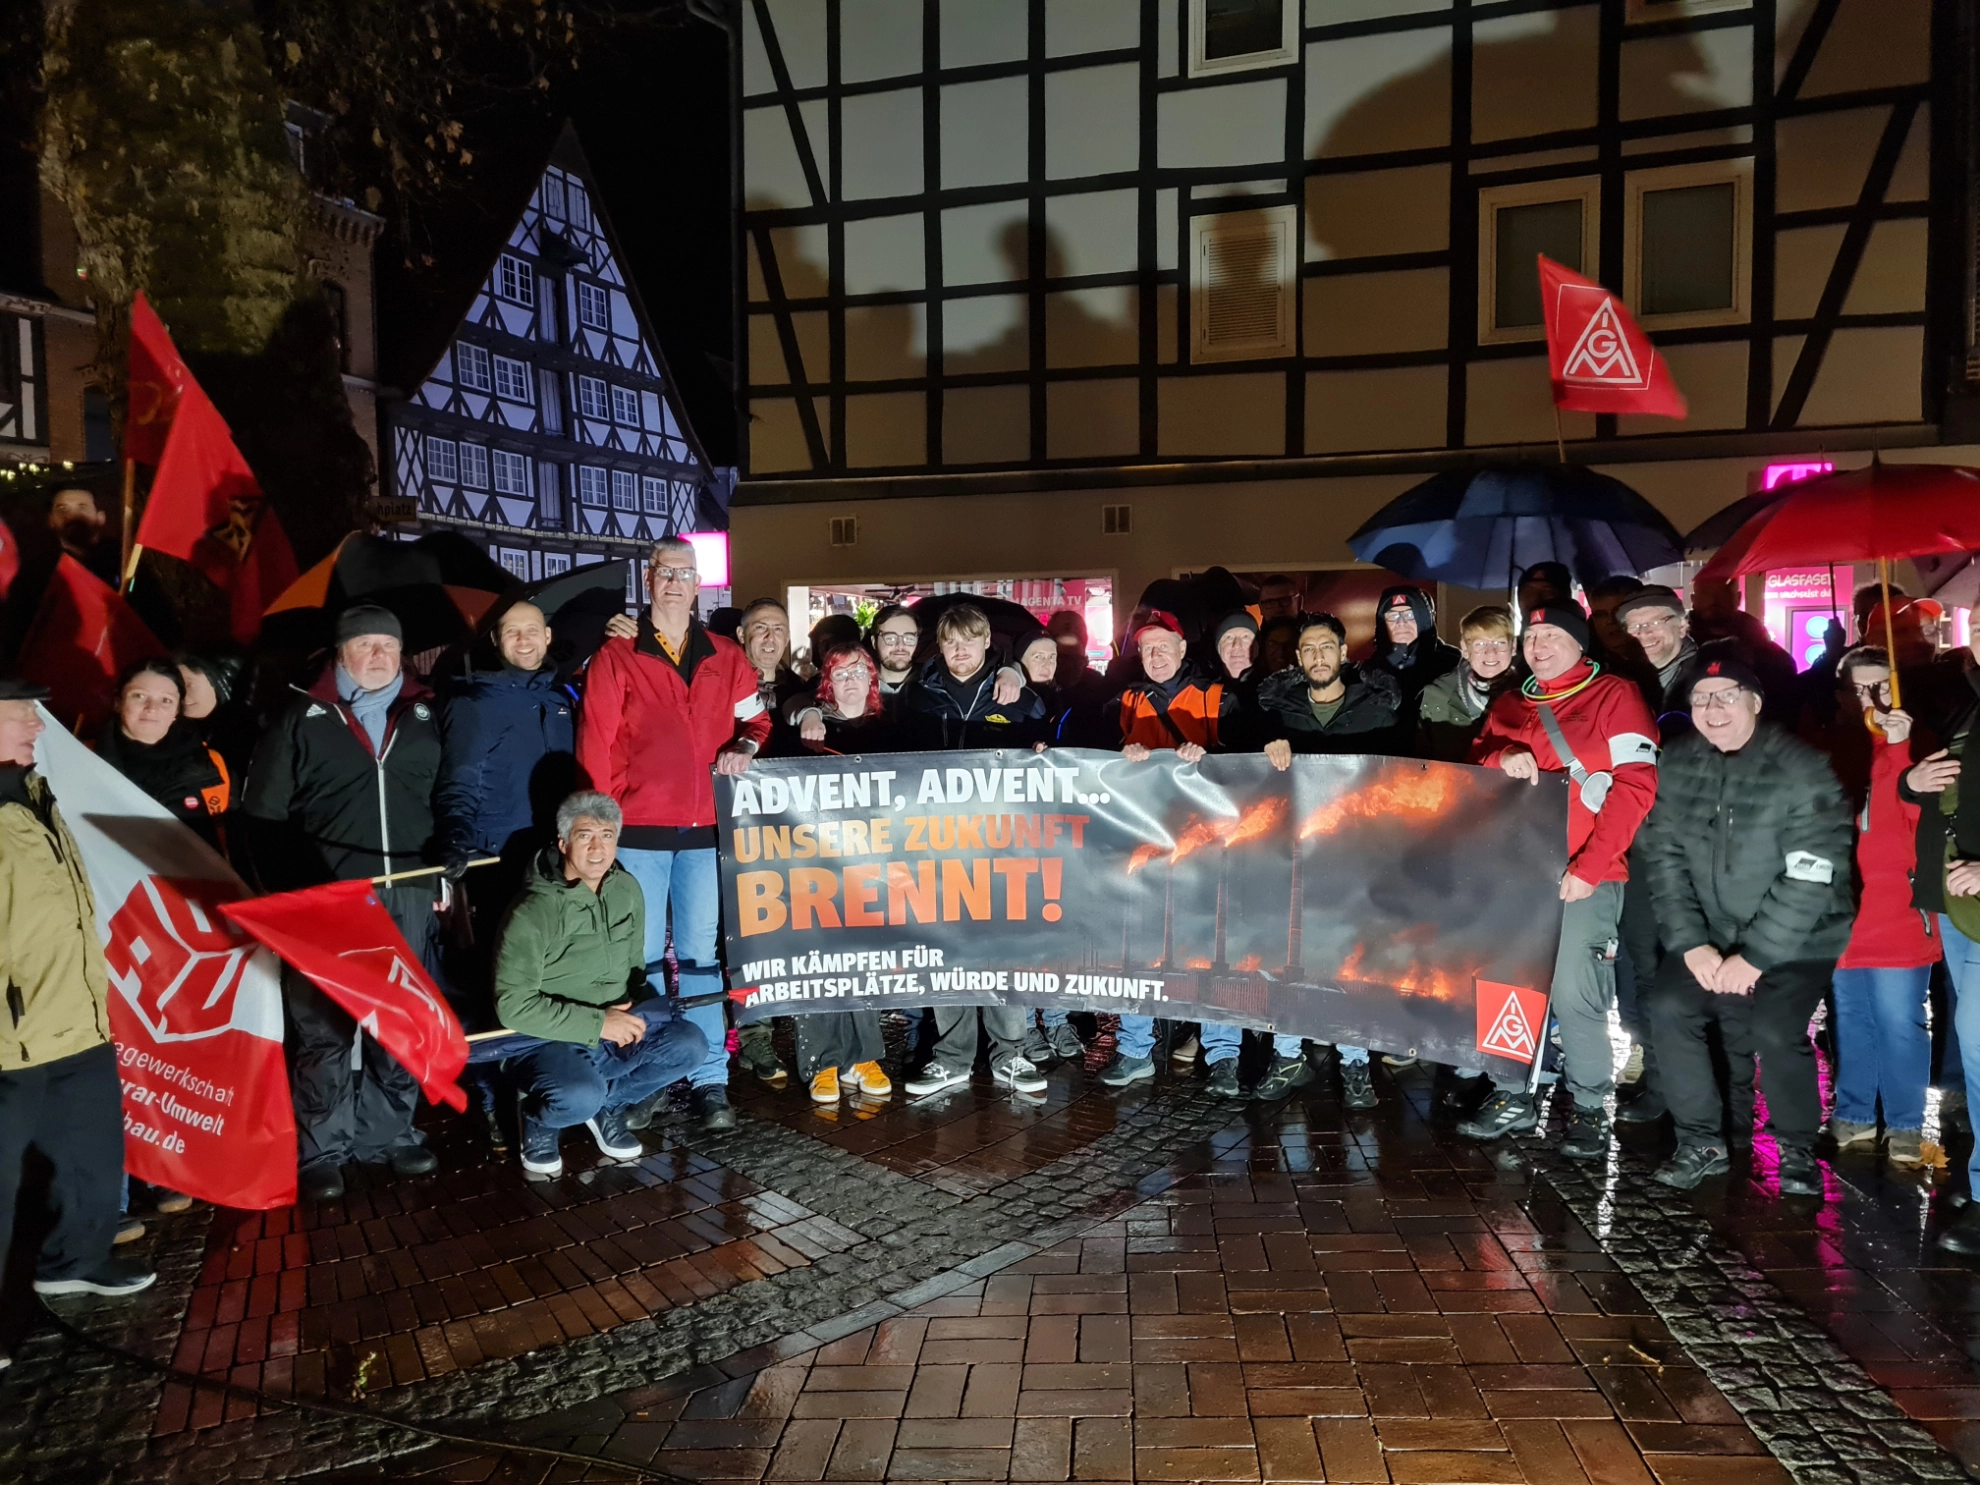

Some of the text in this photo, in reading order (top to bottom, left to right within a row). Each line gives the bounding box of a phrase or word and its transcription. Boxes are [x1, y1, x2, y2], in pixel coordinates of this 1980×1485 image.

[1014, 595, 1082, 607] AGENTA TV
[732, 767, 1111, 817] ADVENT, ADVENT...
[733, 814, 1090, 863] UNSERE ZUKUNFT
[737, 857, 1063, 938] BRENNT!
[742, 945, 944, 983] WIR KÄMPFEN FÜR
[745, 967, 1169, 1008] ARBEITSPLÄTZE, WÜRDE UND ZUKUNFT.
[121, 1079, 226, 1136] rar-Umwelt
